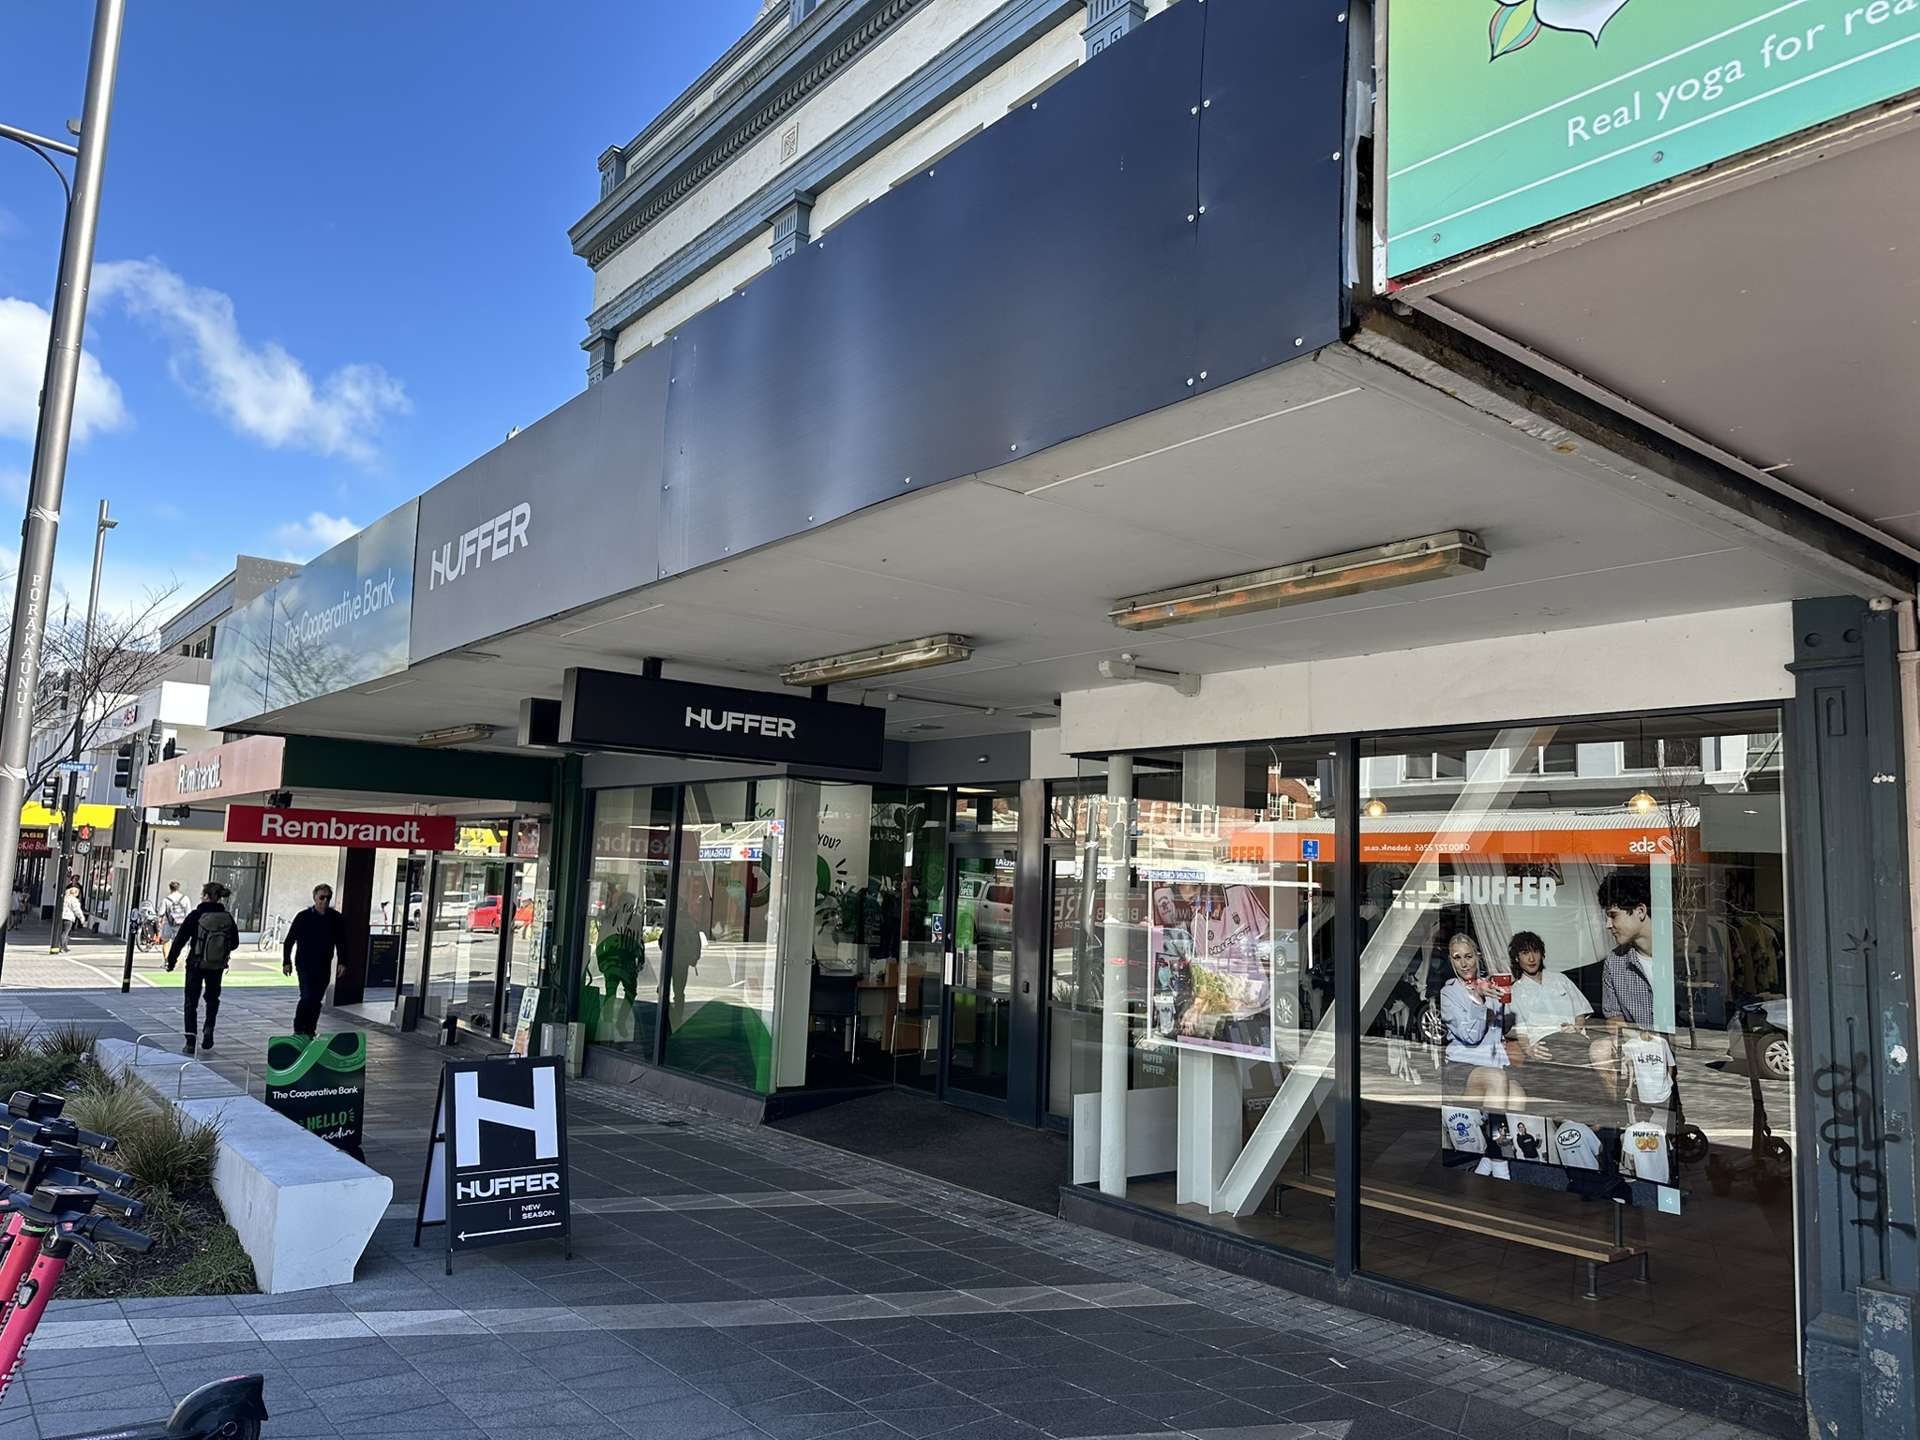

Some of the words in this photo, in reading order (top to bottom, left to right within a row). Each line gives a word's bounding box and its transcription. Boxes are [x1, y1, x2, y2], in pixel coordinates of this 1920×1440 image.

[1567, 91, 1641, 147] Real
[1656, 58, 1745, 121] yoga
[1761, 21, 1825, 68] for
[430, 502, 531, 590] HUFFER
[285, 620, 299, 648] The
[301, 591, 361, 645] Cooperative
[363, 568, 395, 616] Bank
[685, 706, 796, 739] HUFFER
[261, 813, 425, 844] Rembrandt.
[1454, 875, 1556, 907] HUFFER
[272, 1091, 288, 1099] The
[289, 1088, 337, 1099] Cooperative
[338, 1086, 358, 1095] Bank
[307, 1111, 347, 1130] HELLO
[456, 1172, 560, 1200] HUFFER
[522, 1203, 541, 1211] NEW
[522, 1210, 555, 1219] SEASON
